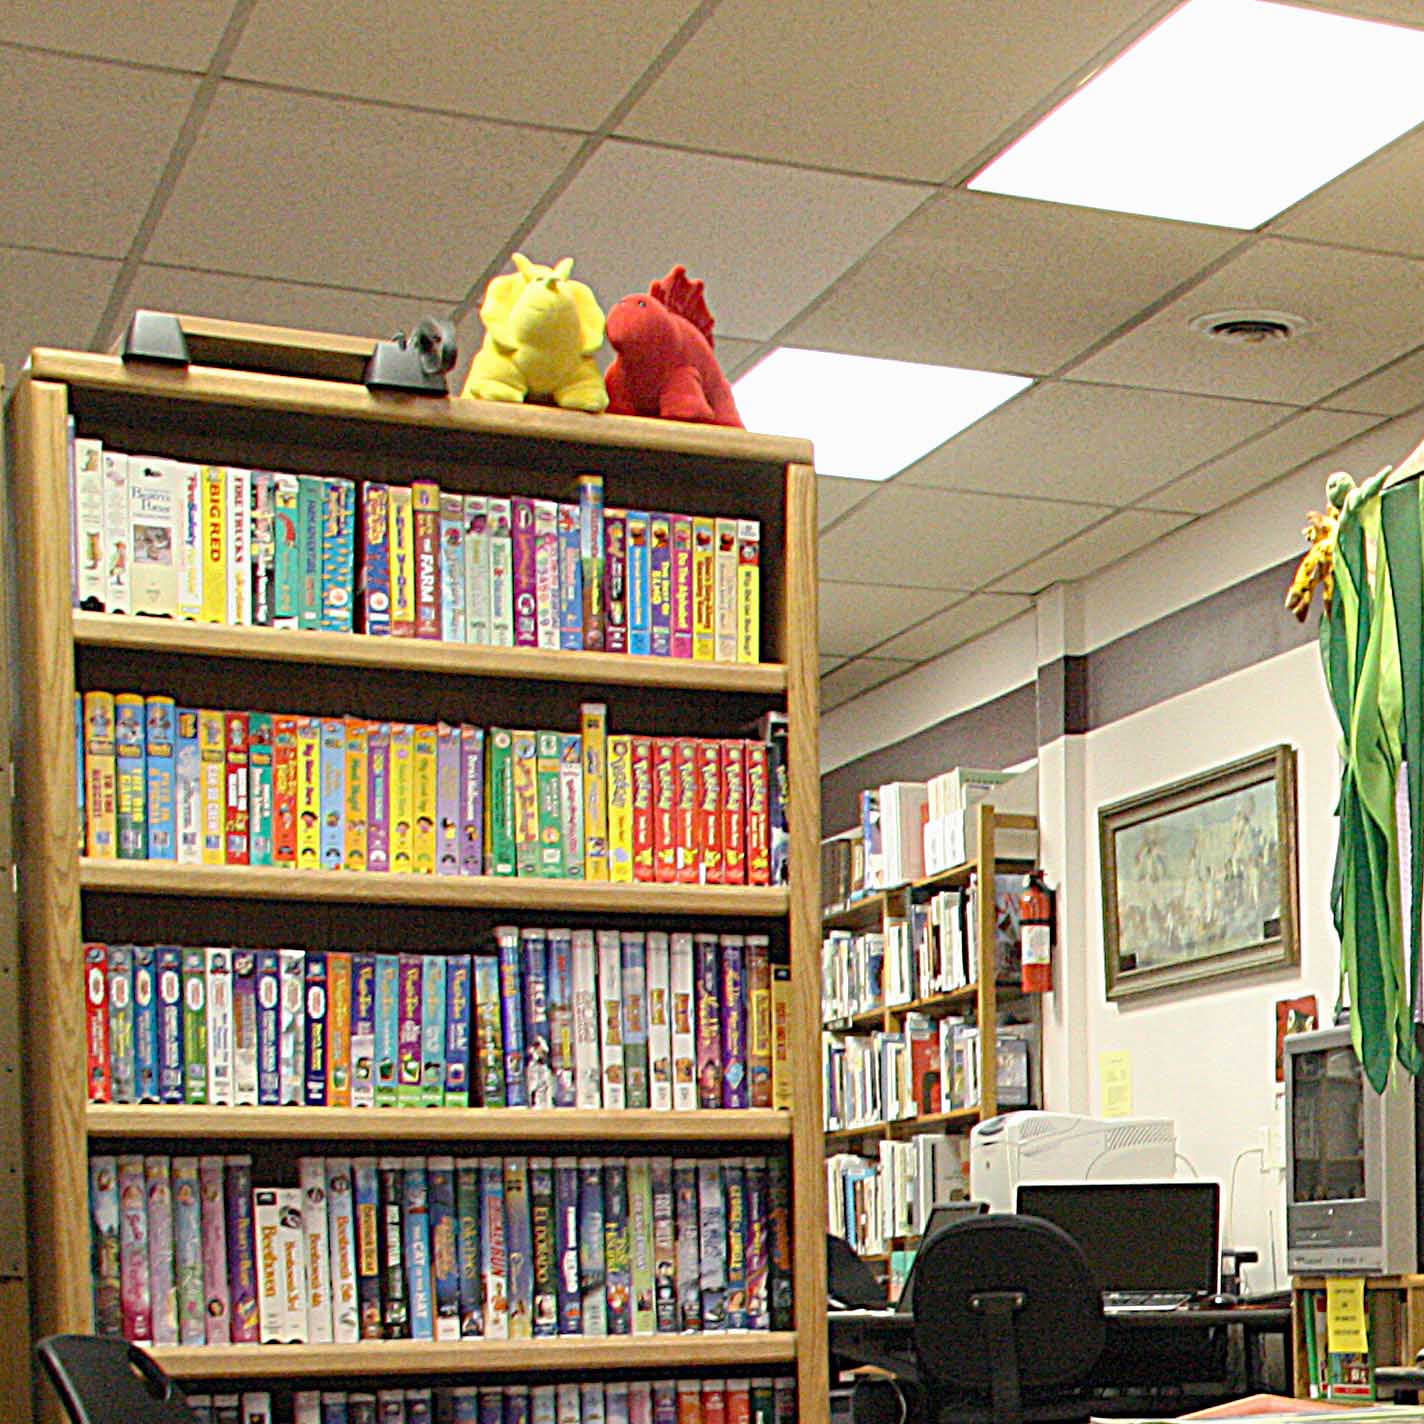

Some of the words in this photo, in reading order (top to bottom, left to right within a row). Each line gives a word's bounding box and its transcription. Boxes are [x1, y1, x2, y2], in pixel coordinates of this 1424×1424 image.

[209, 483, 221, 517] BIG
[209, 522, 221, 563] RED
[679, 552, 688, 565] Do
[421, 554, 435, 602] FARM
[679, 567, 688, 583] The
[676, 585, 688, 628] Alphabet
[262, 1226, 277, 1297] Beethoven
[412, 1241, 424, 1266] CAT
